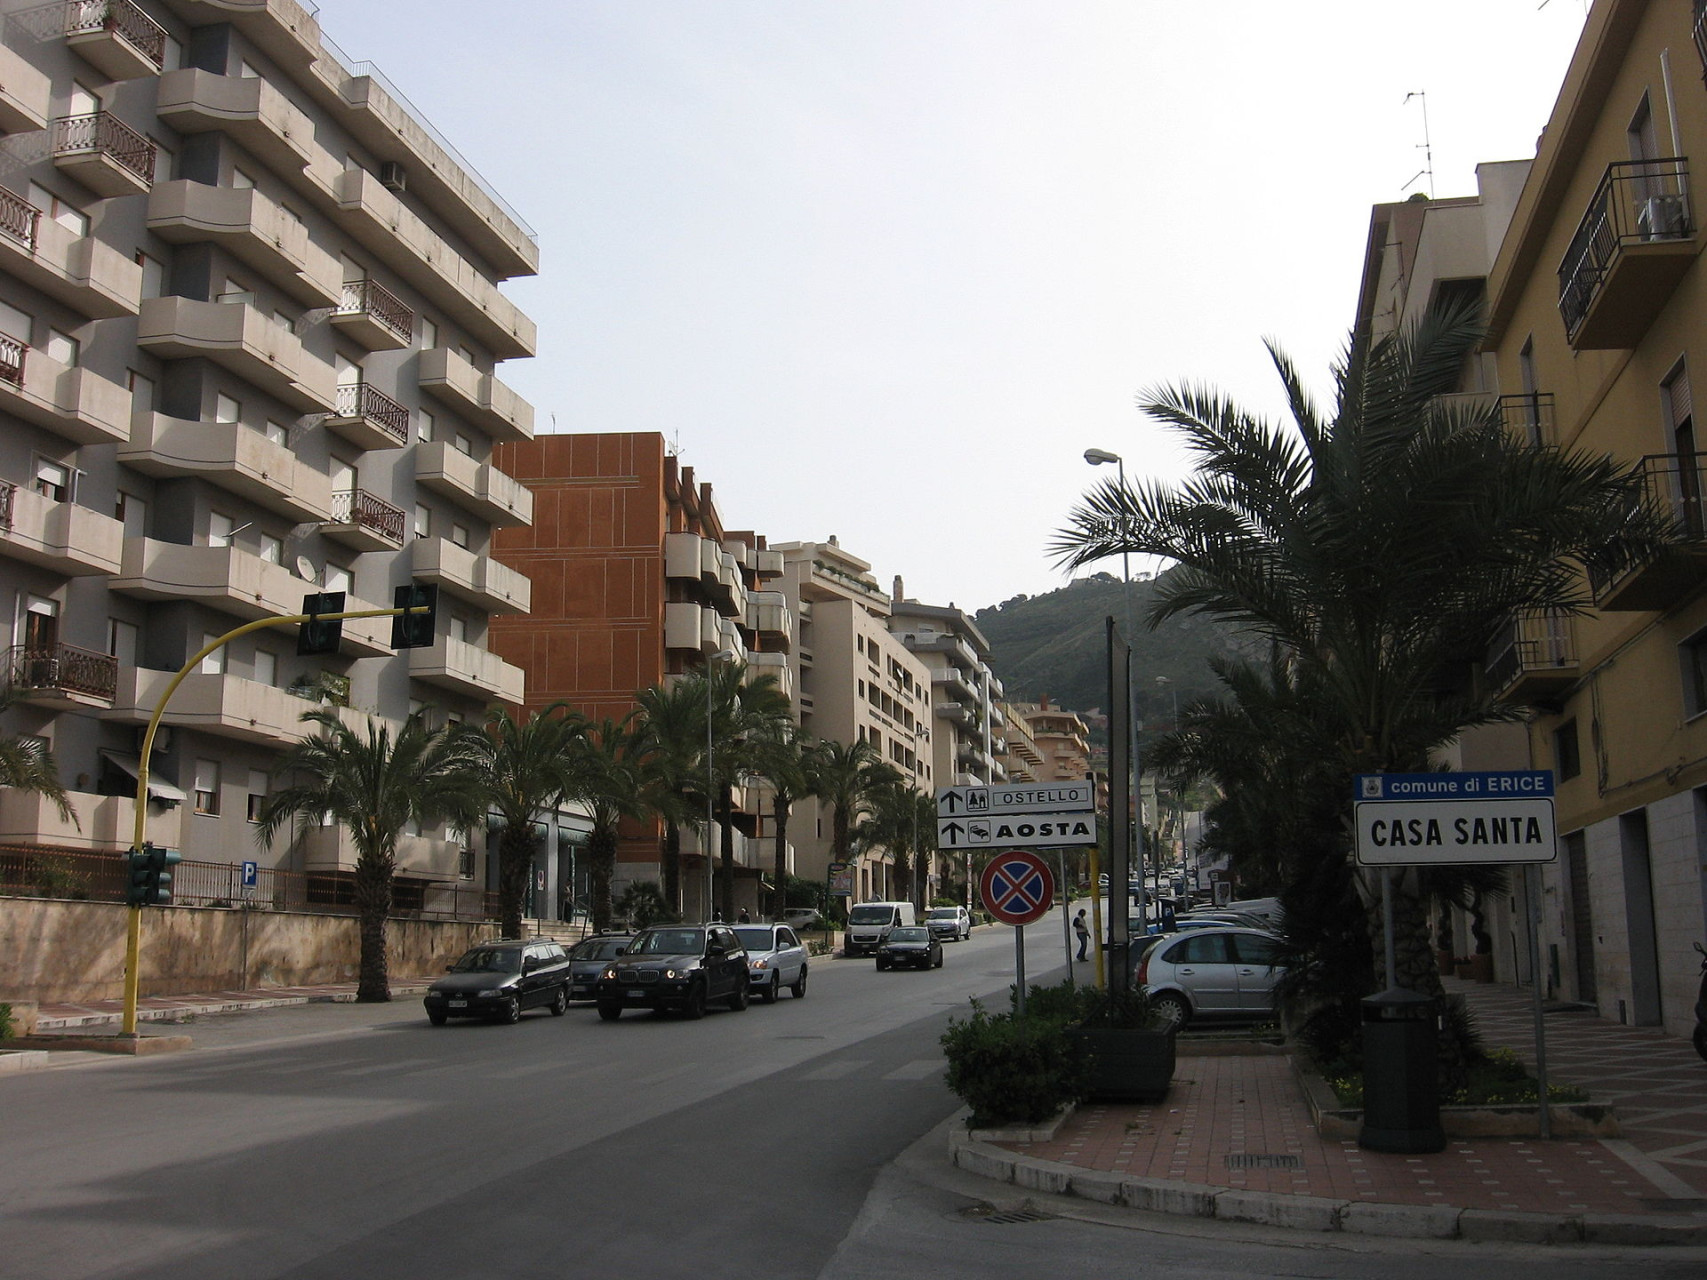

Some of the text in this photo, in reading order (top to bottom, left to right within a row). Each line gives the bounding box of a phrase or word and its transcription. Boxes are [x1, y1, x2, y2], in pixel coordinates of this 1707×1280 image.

[1391, 776, 1545, 793] comune di ERICE
[1003, 789, 1079, 804] OSTELLO
[996, 822, 1090, 838] AOSTA
[1371, 816, 1543, 847] CASA SANTA
[244, 863, 255, 883] P
